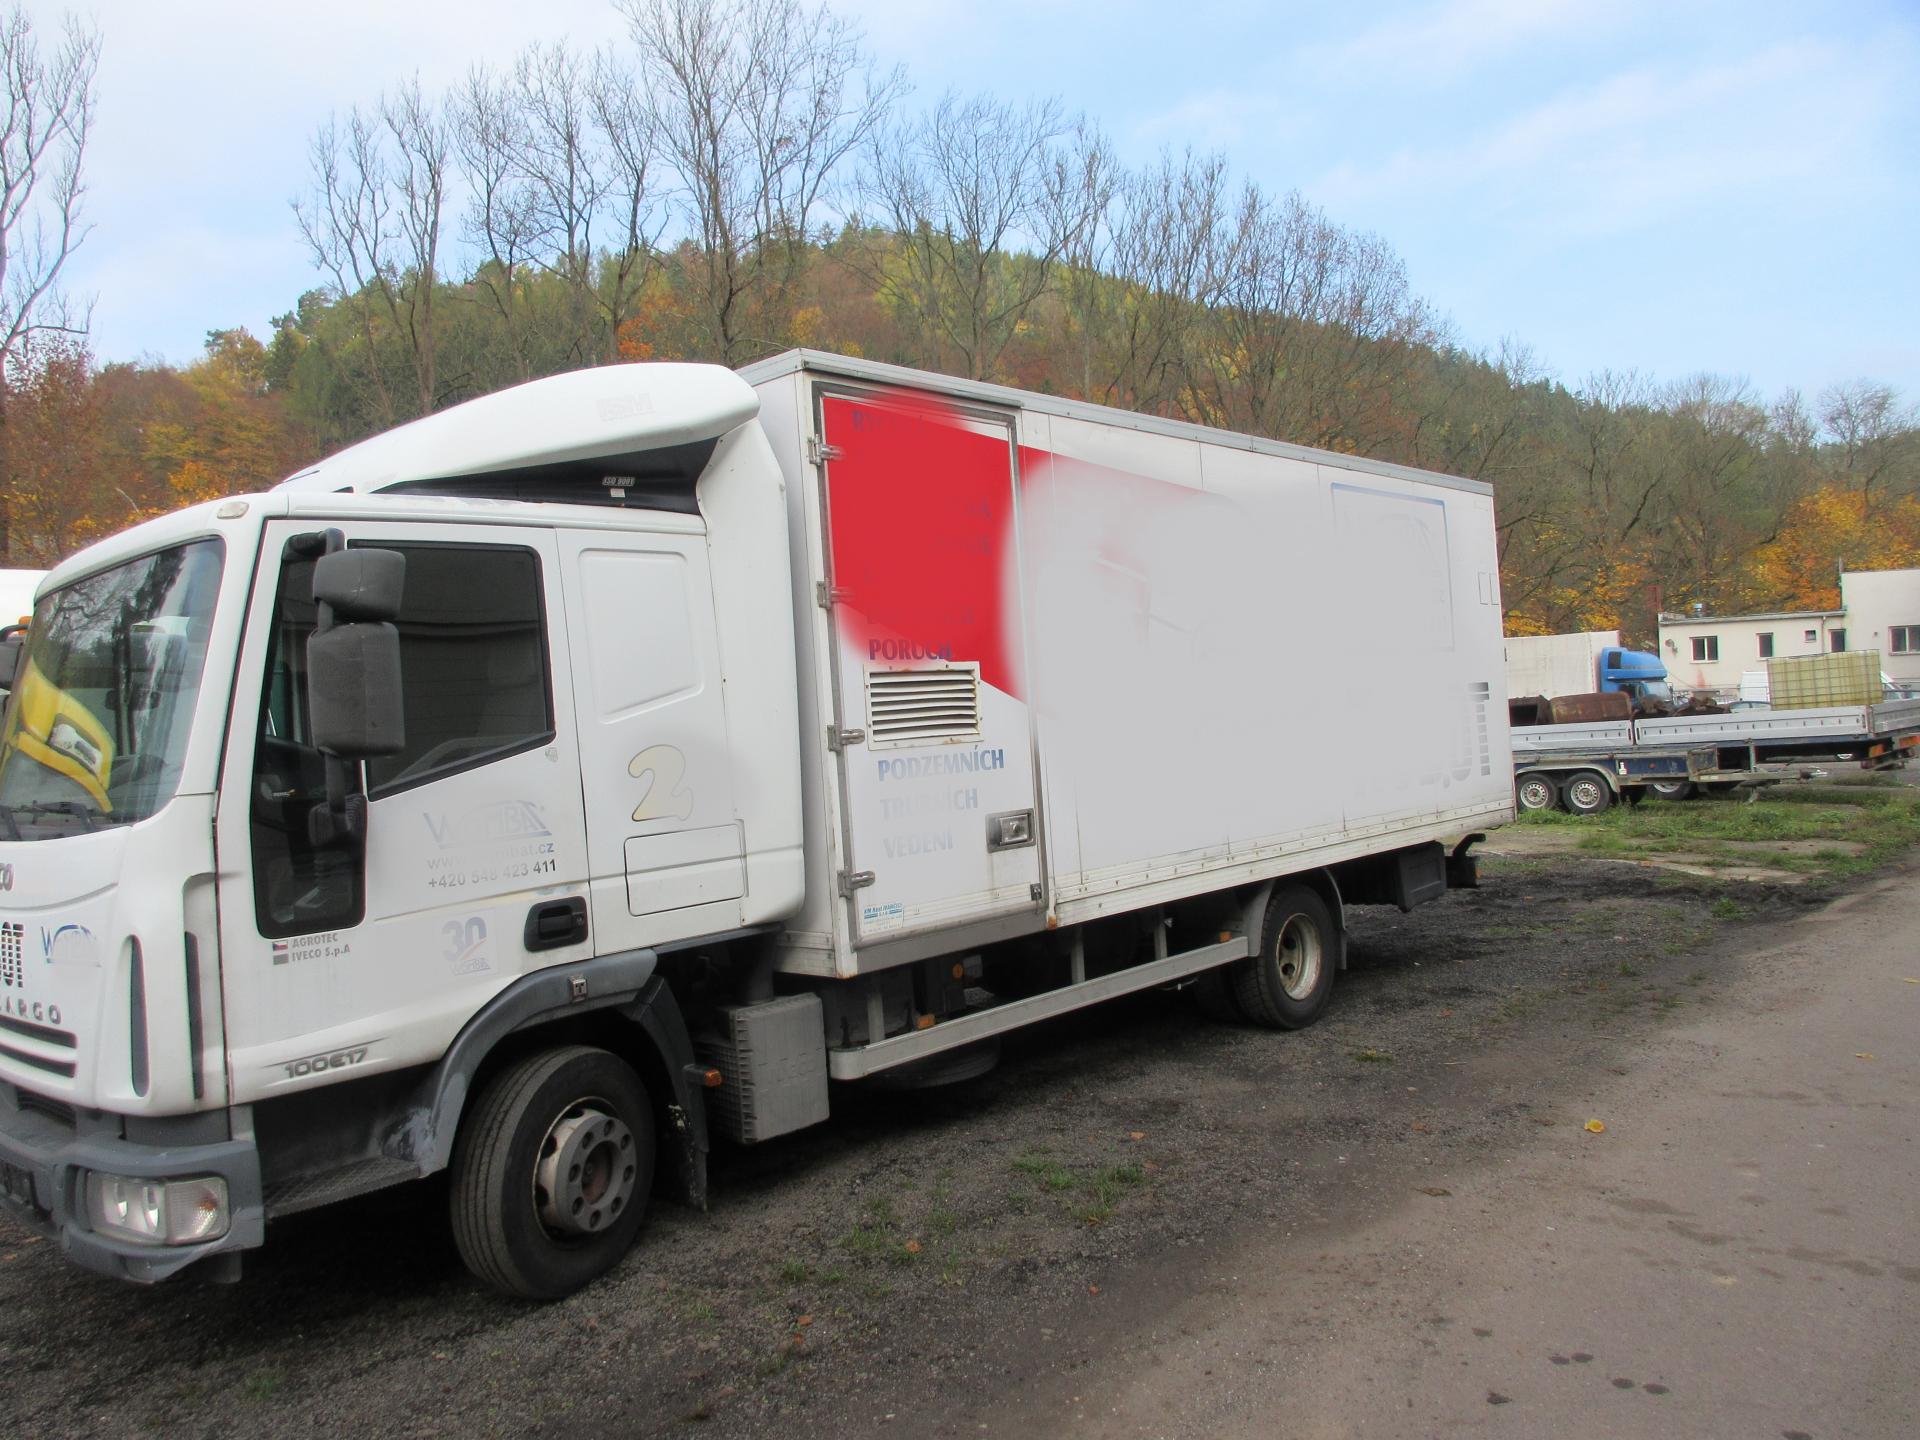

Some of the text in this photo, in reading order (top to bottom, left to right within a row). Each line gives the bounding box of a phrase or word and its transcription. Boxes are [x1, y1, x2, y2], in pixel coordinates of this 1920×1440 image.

[869, 639, 953, 661] PORUCH
[877, 744, 1005, 782] PODZEMNÍCH
[628, 744, 694, 822] 2
[428, 873, 466, 888] +420
[533, 859, 556, 874] 411
[291, 933, 338, 948] AGROTEC
[292, 943, 351, 962] IVECO S.p.A
[441, 916, 487, 962] 30
[0, 995, 62, 1025] ARGO
[284, 1046, 368, 1079] 100E17
